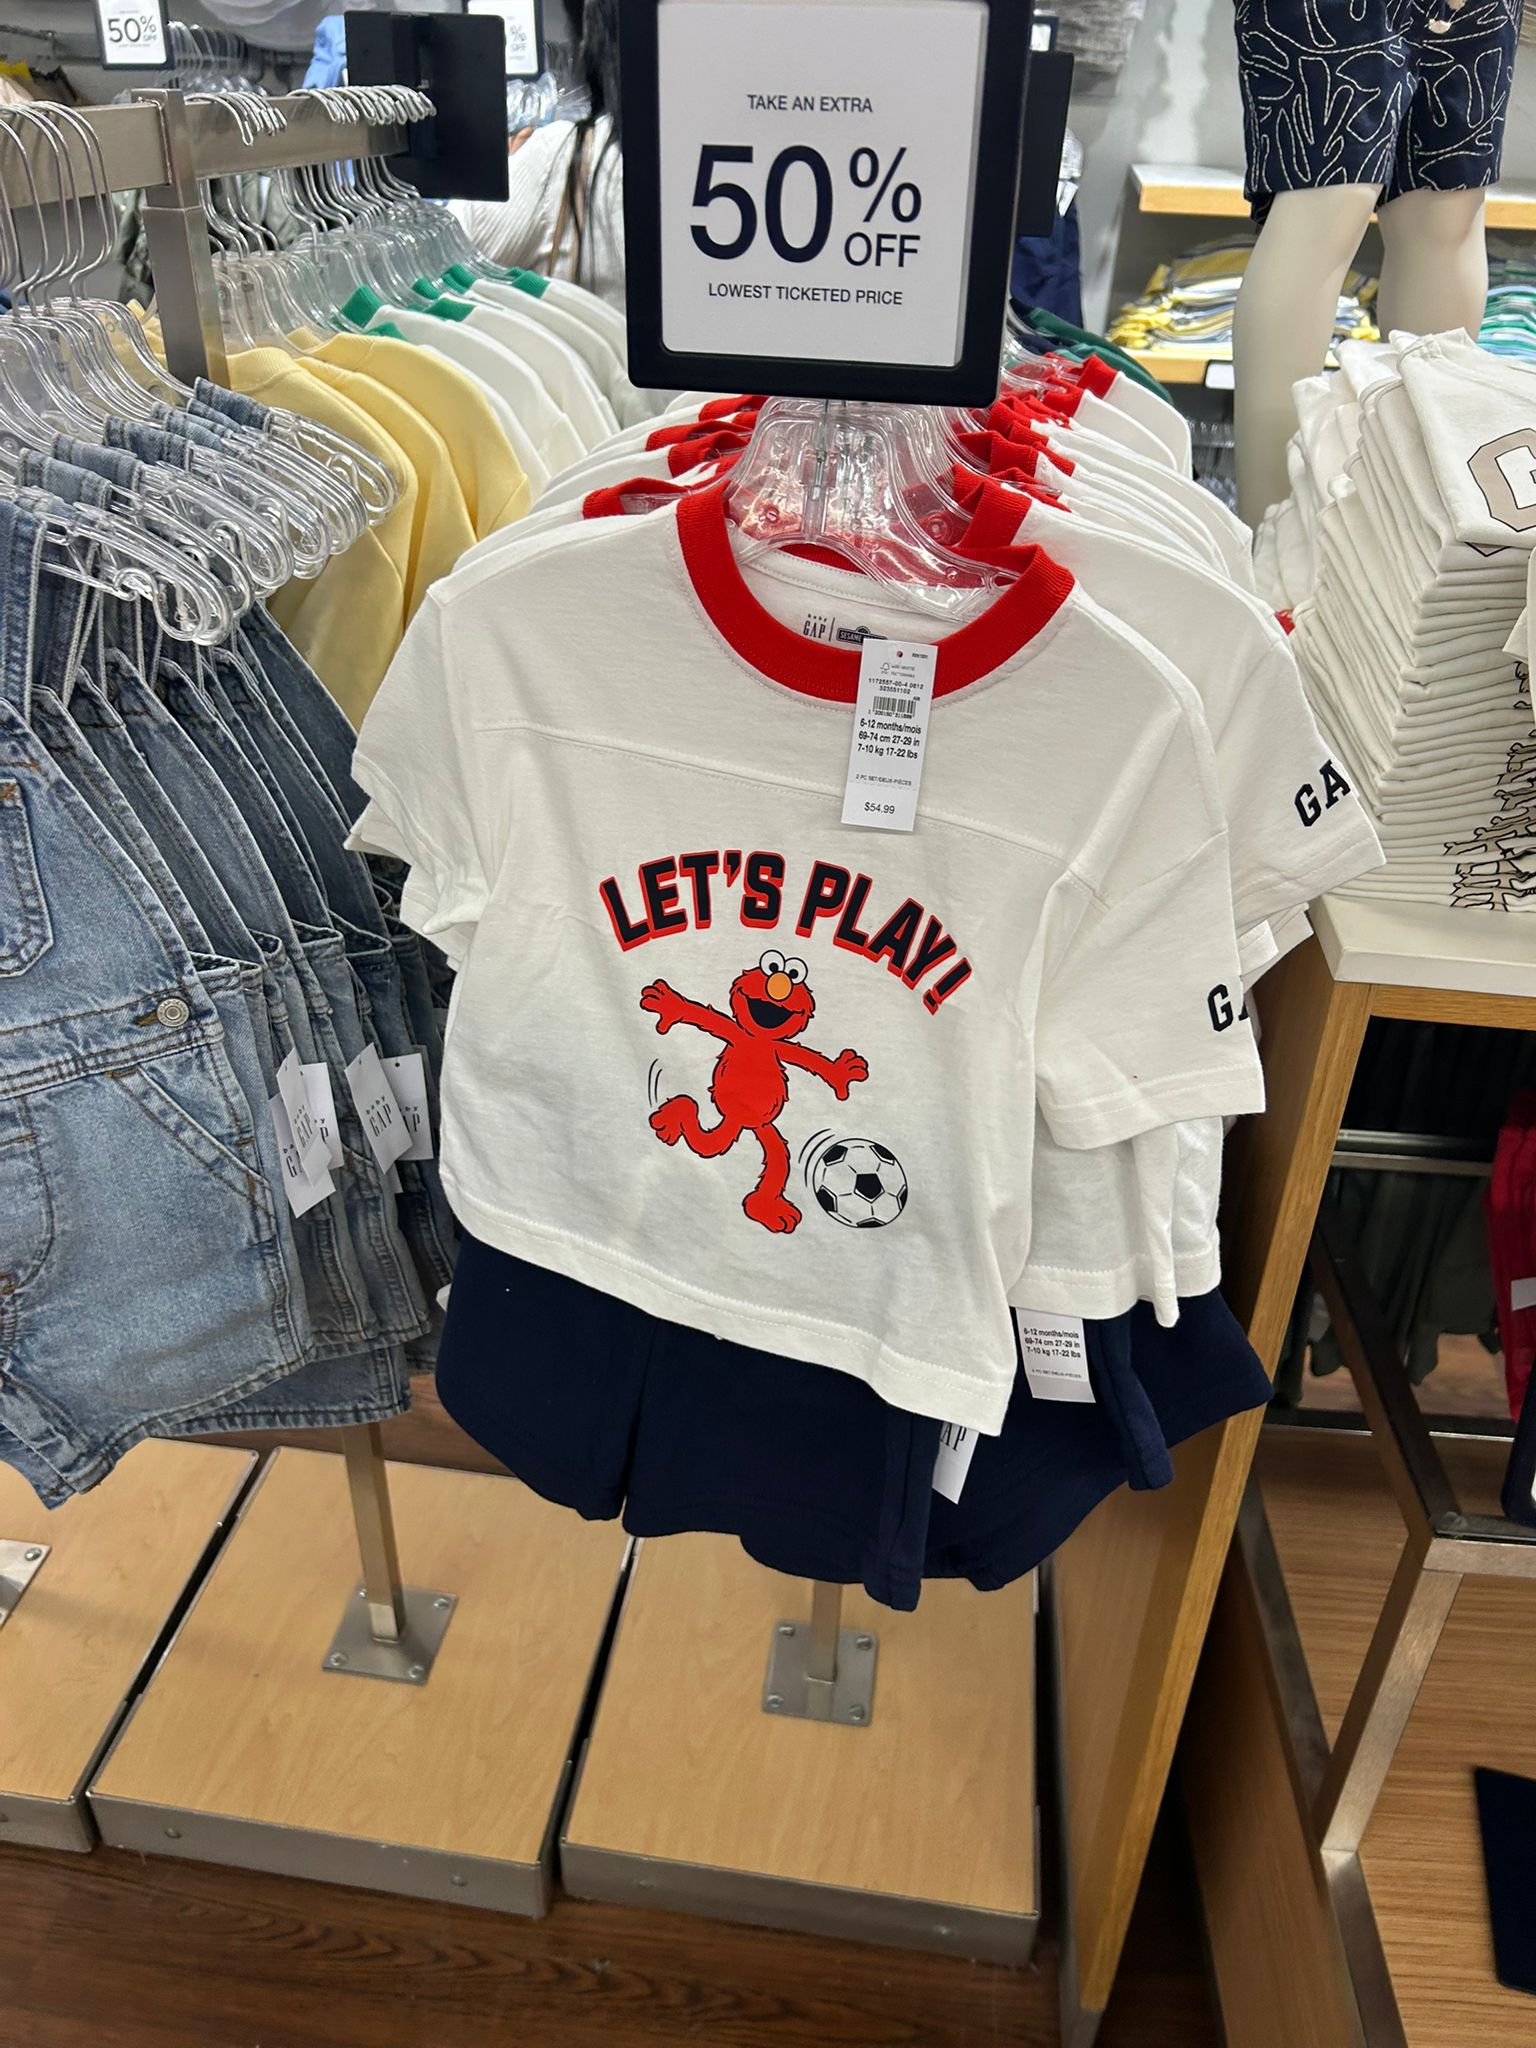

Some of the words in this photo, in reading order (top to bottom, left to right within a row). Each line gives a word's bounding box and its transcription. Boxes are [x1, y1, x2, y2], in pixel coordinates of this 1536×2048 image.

[747, 94, 788, 111] TAKE
[792, 96, 816, 111] AN
[819, 97, 873, 113] EXTRA
[844, 232, 921, 267] OFF
[708, 283, 772, 300] LOWEST
[776, 285, 850, 303] TICKETED
[855, 288, 903, 306] PRICE
[803, 620, 826, 639] GAP
[860, 718, 876, 729] 6-12
[876, 721, 922, 735] months/mois
[858, 731, 878, 741] 69-74
[880, 735, 891, 743] cm
[892, 735, 912, 746] 27-29
[913, 737, 920, 747] in
[857, 743, 874, 753] 7-10
[874, 745, 884, 757] kg
[886, 747, 906, 758] 17-22
[907, 750, 918, 759] lbs
[864, 802, 895, 815] $54.99
[600, 850, 786, 952] LET'S
[795, 860, 972, 1015] PLAY!
[370, 1104, 392, 1137] GAP
